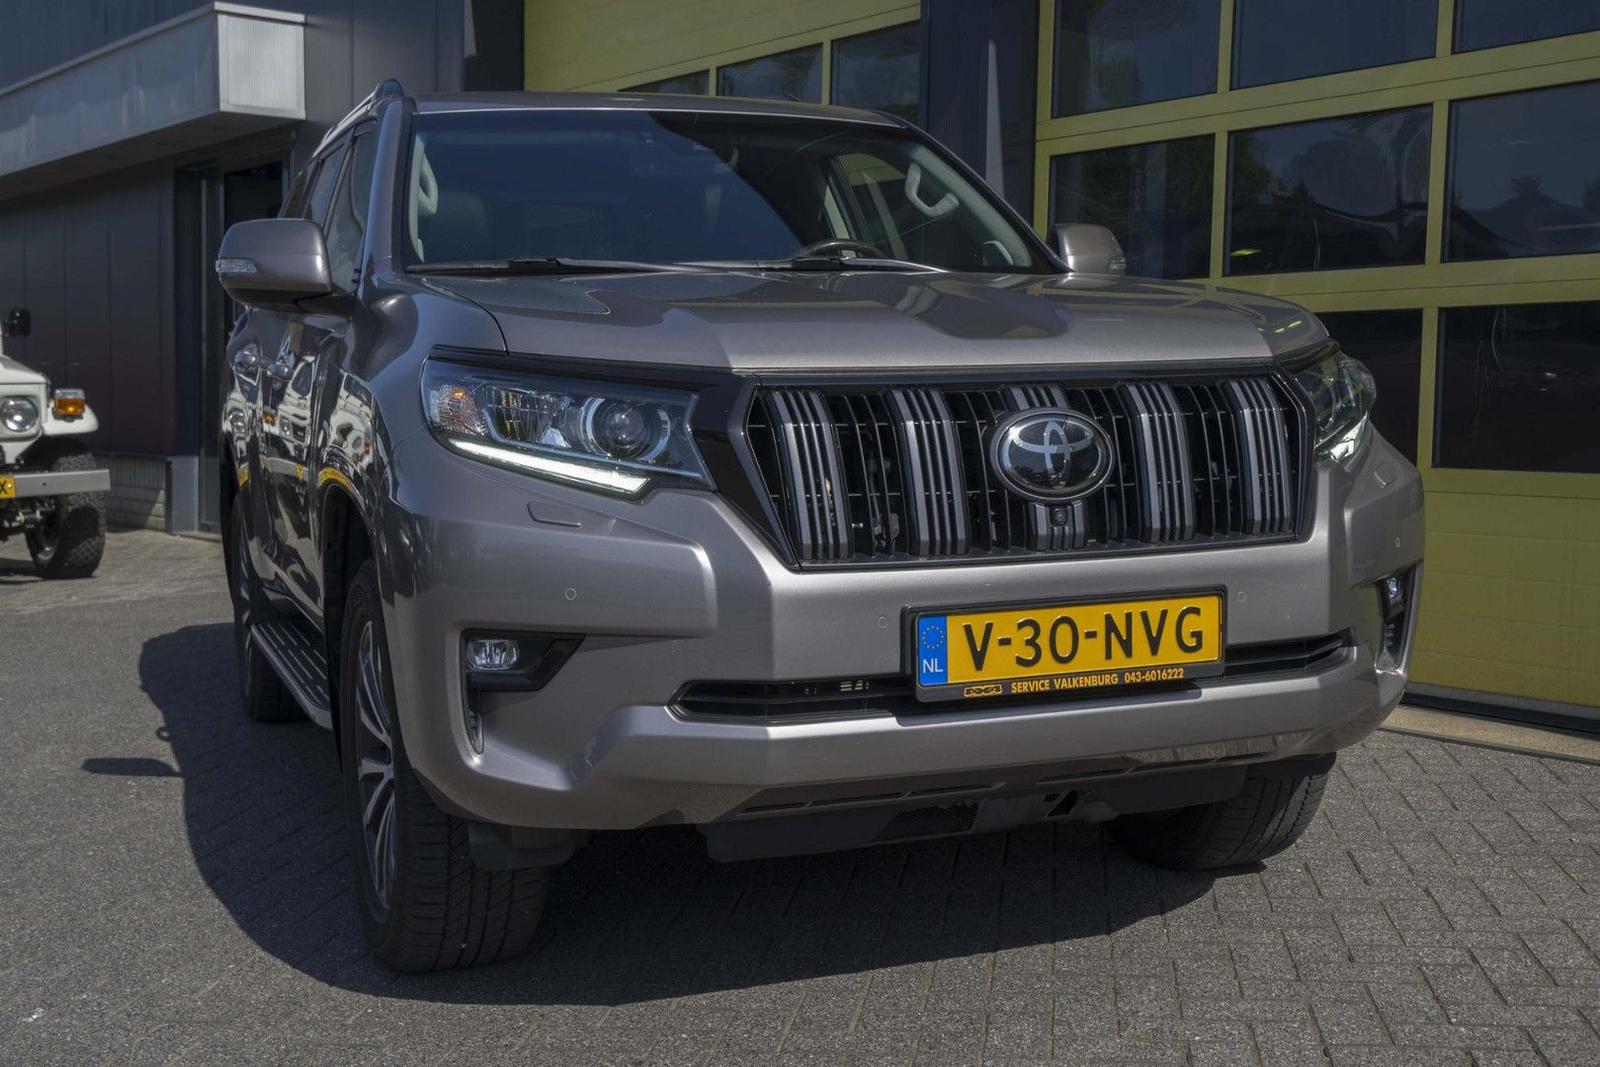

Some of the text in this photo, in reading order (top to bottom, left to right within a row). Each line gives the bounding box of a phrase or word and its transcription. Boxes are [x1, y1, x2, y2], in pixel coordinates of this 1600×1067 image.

[962, 606, 1203, 671] V-30-NVG
[922, 658, 943, 674] NL
[1011, 679, 1050, 693] SERVICE
[1053, 674, 1119, 692] VALKENBURG
[1124, 668, 1185, 684] 043-6016222
